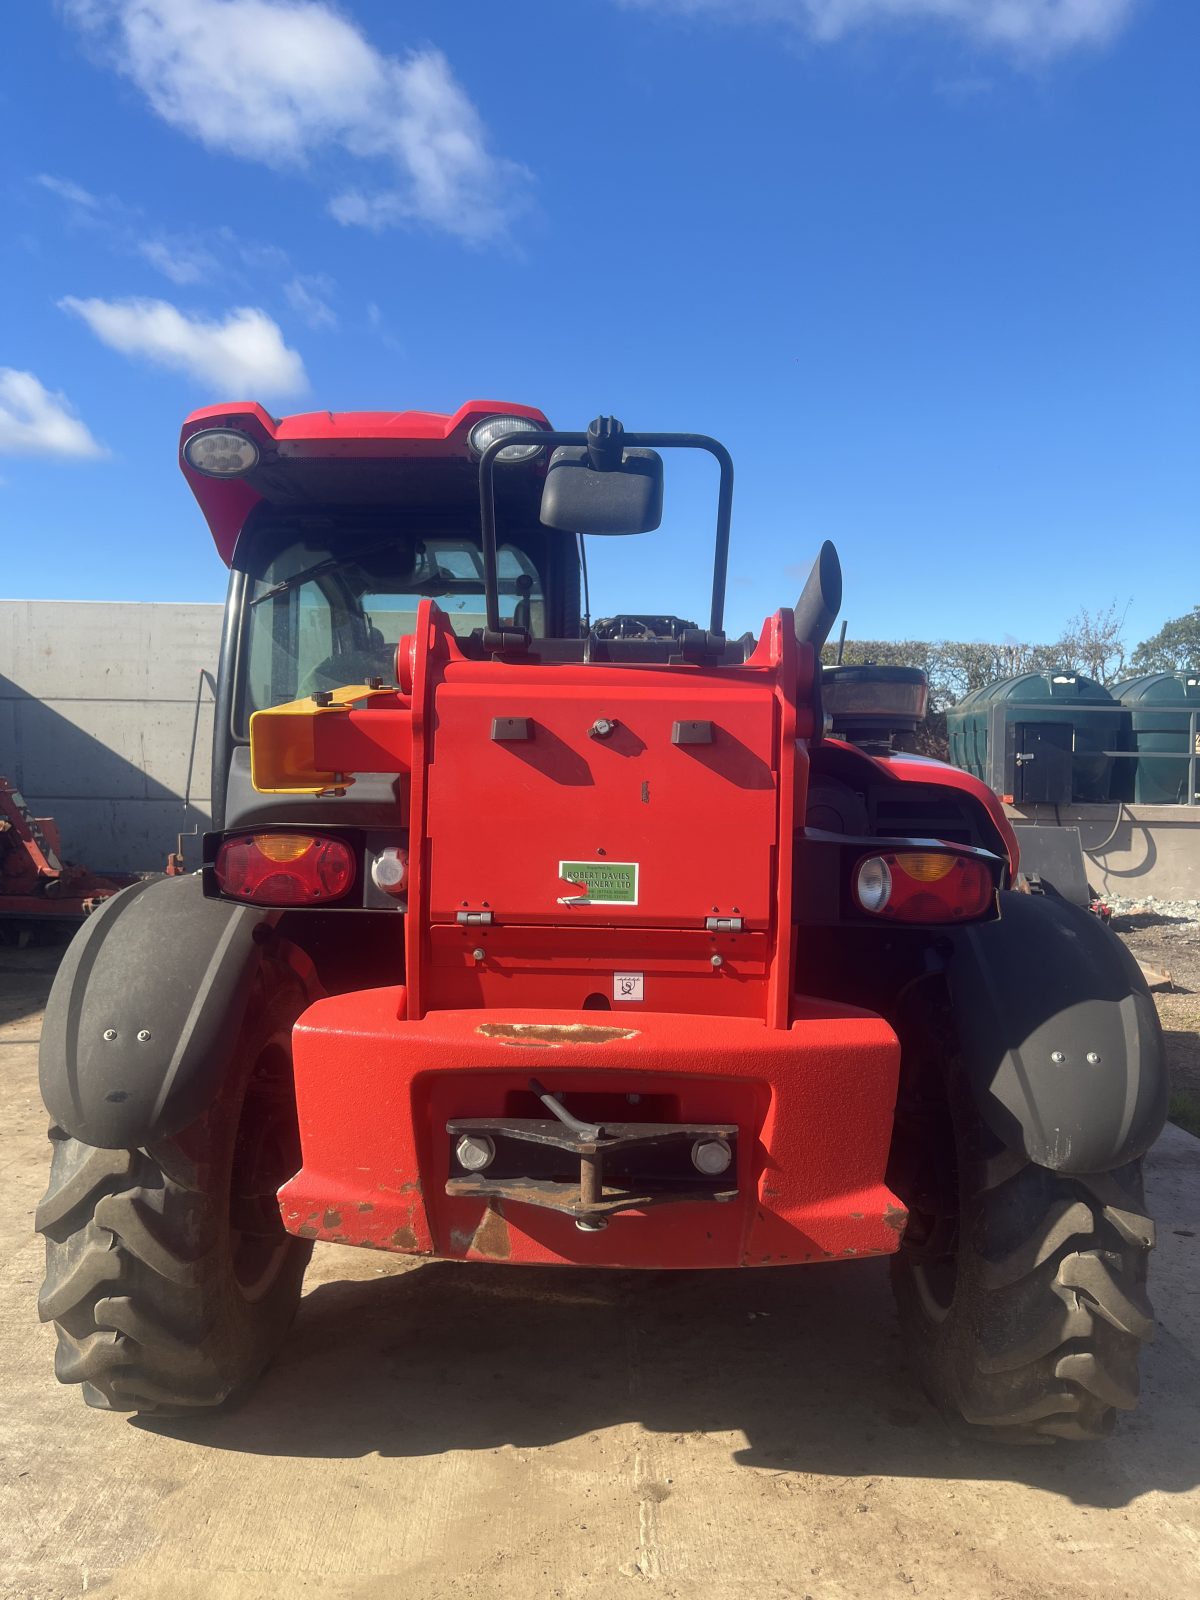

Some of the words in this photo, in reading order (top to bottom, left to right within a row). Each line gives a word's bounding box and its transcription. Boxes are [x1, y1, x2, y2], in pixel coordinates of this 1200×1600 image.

[567, 871, 599, 879] ROBERT
[601, 872, 630, 880] DAVIES
[616, 881, 631, 889] LTD
